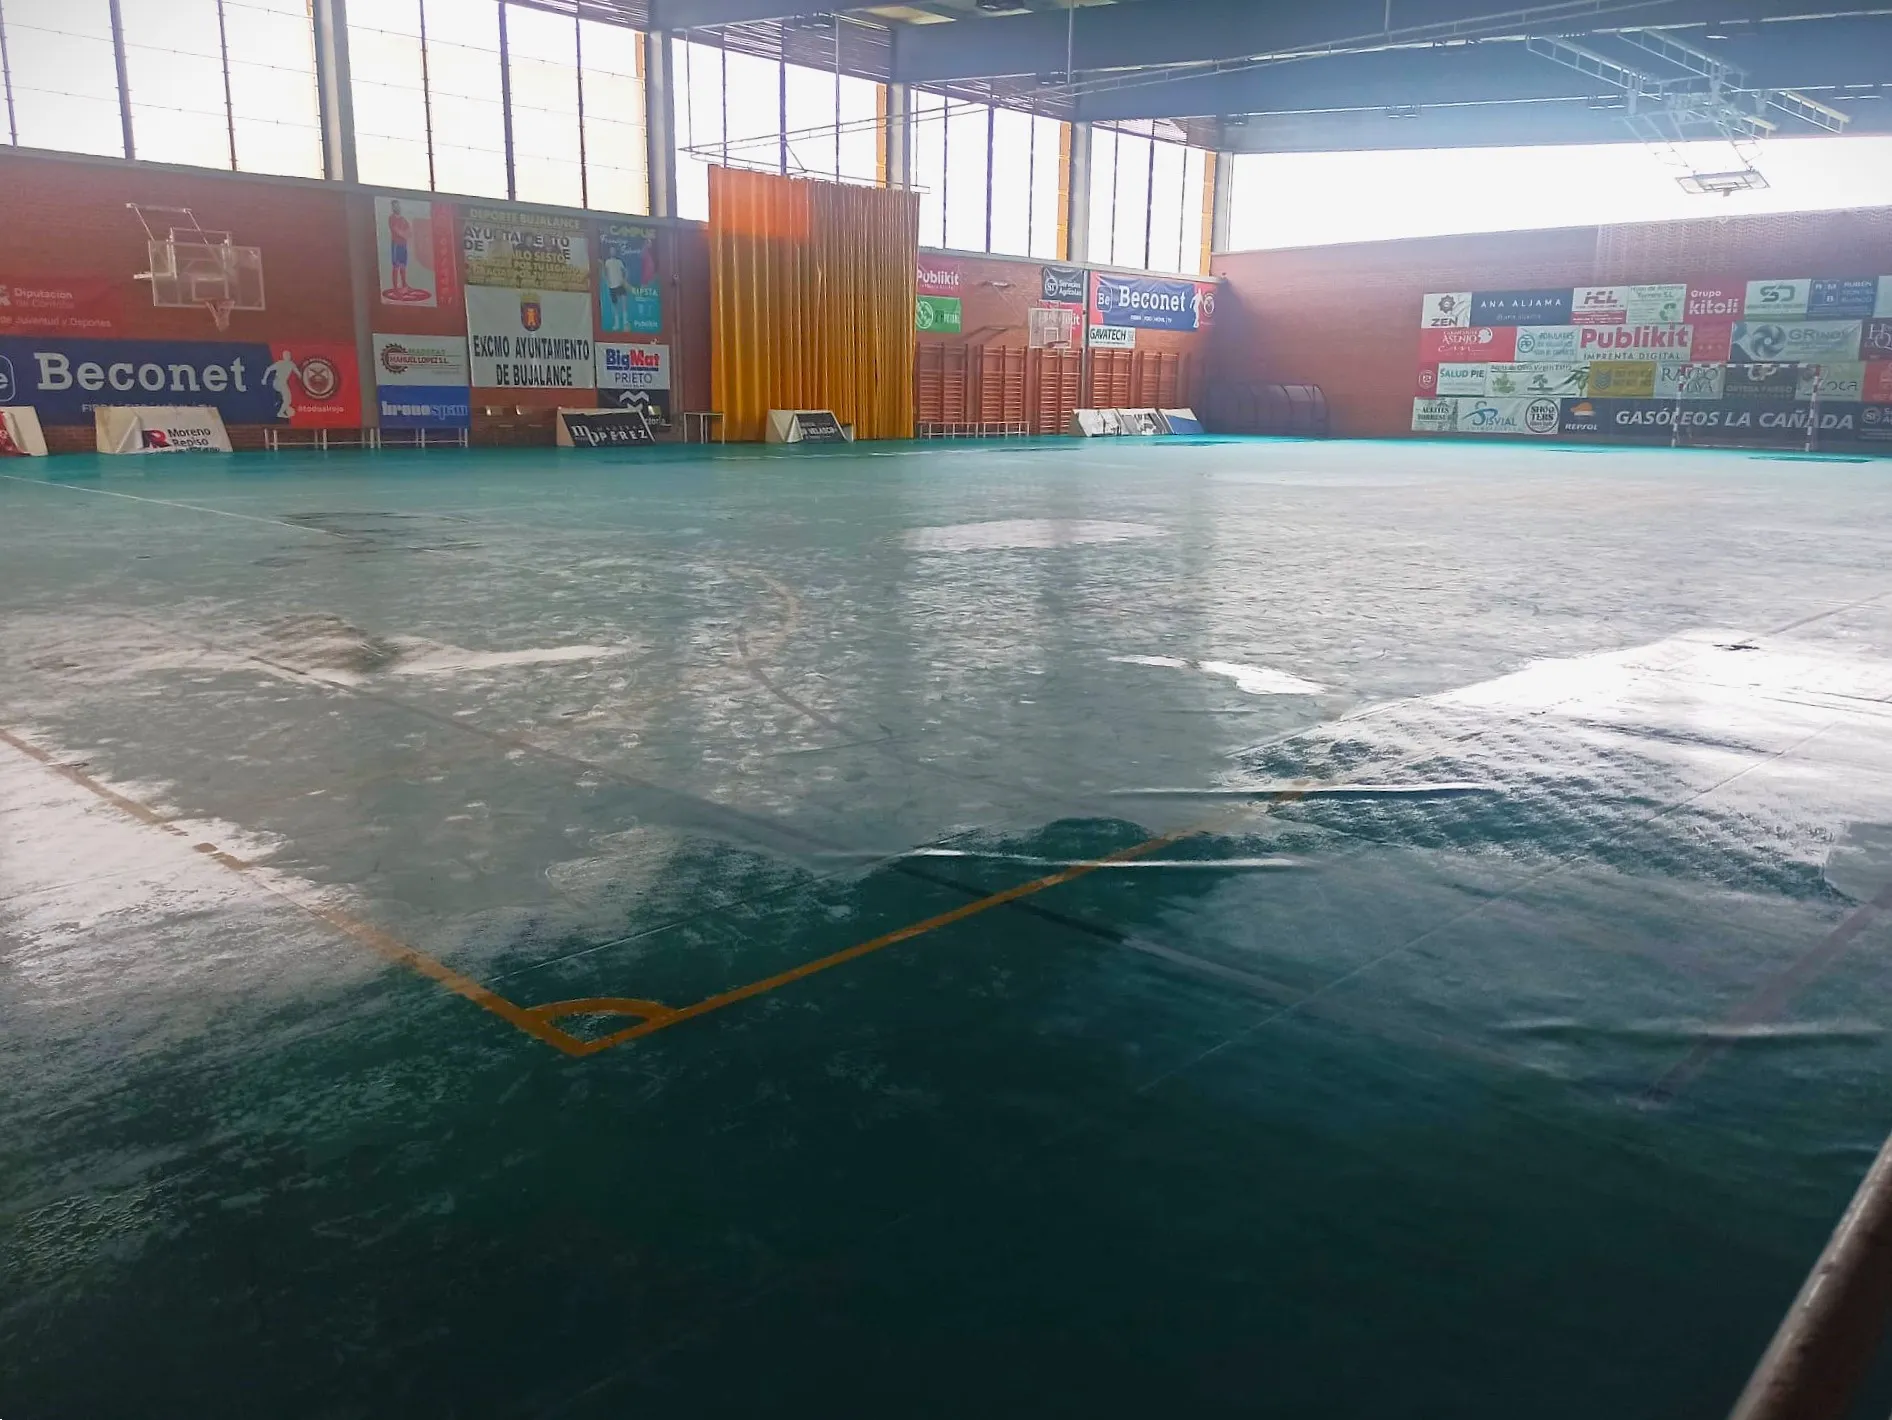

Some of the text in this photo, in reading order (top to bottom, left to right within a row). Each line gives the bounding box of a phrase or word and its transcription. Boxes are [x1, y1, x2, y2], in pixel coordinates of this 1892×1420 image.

[1097, 285, 1186, 312] Be Beconet
[1690, 289, 1722, 298] Grupo
[1480, 298, 1562, 308] ANA ALJAMA
[1688, 298, 1740, 316] kitoli
[1431, 317, 1459, 327] ZEN
[1090, 328, 1126, 341] GAVATECH
[1442, 335, 1477, 345] ASENJO
[1580, 323, 1689, 348] Publikit
[473, 335, 590, 361] EXCMO AYUNTAMIENTO
[606, 347, 660, 370] BigMat
[1583, 352, 1634, 361] IMPRENTA
[1638, 351, 1681, 361] DIGITAL
[33, 351, 247, 392] Beconet
[496, 364, 573, 386] DE BUJALANCE
[1440, 368, 1485, 378] SALUD PIE
[615, 372, 653, 384] PRIETO
[1565, 423, 1598, 431] REPSOL
[1724, 411, 1751, 427] LA
[167, 428, 211, 437] Moreno
[600, 430, 649, 442] PEREZ
[172, 436, 209, 447] Repiso
